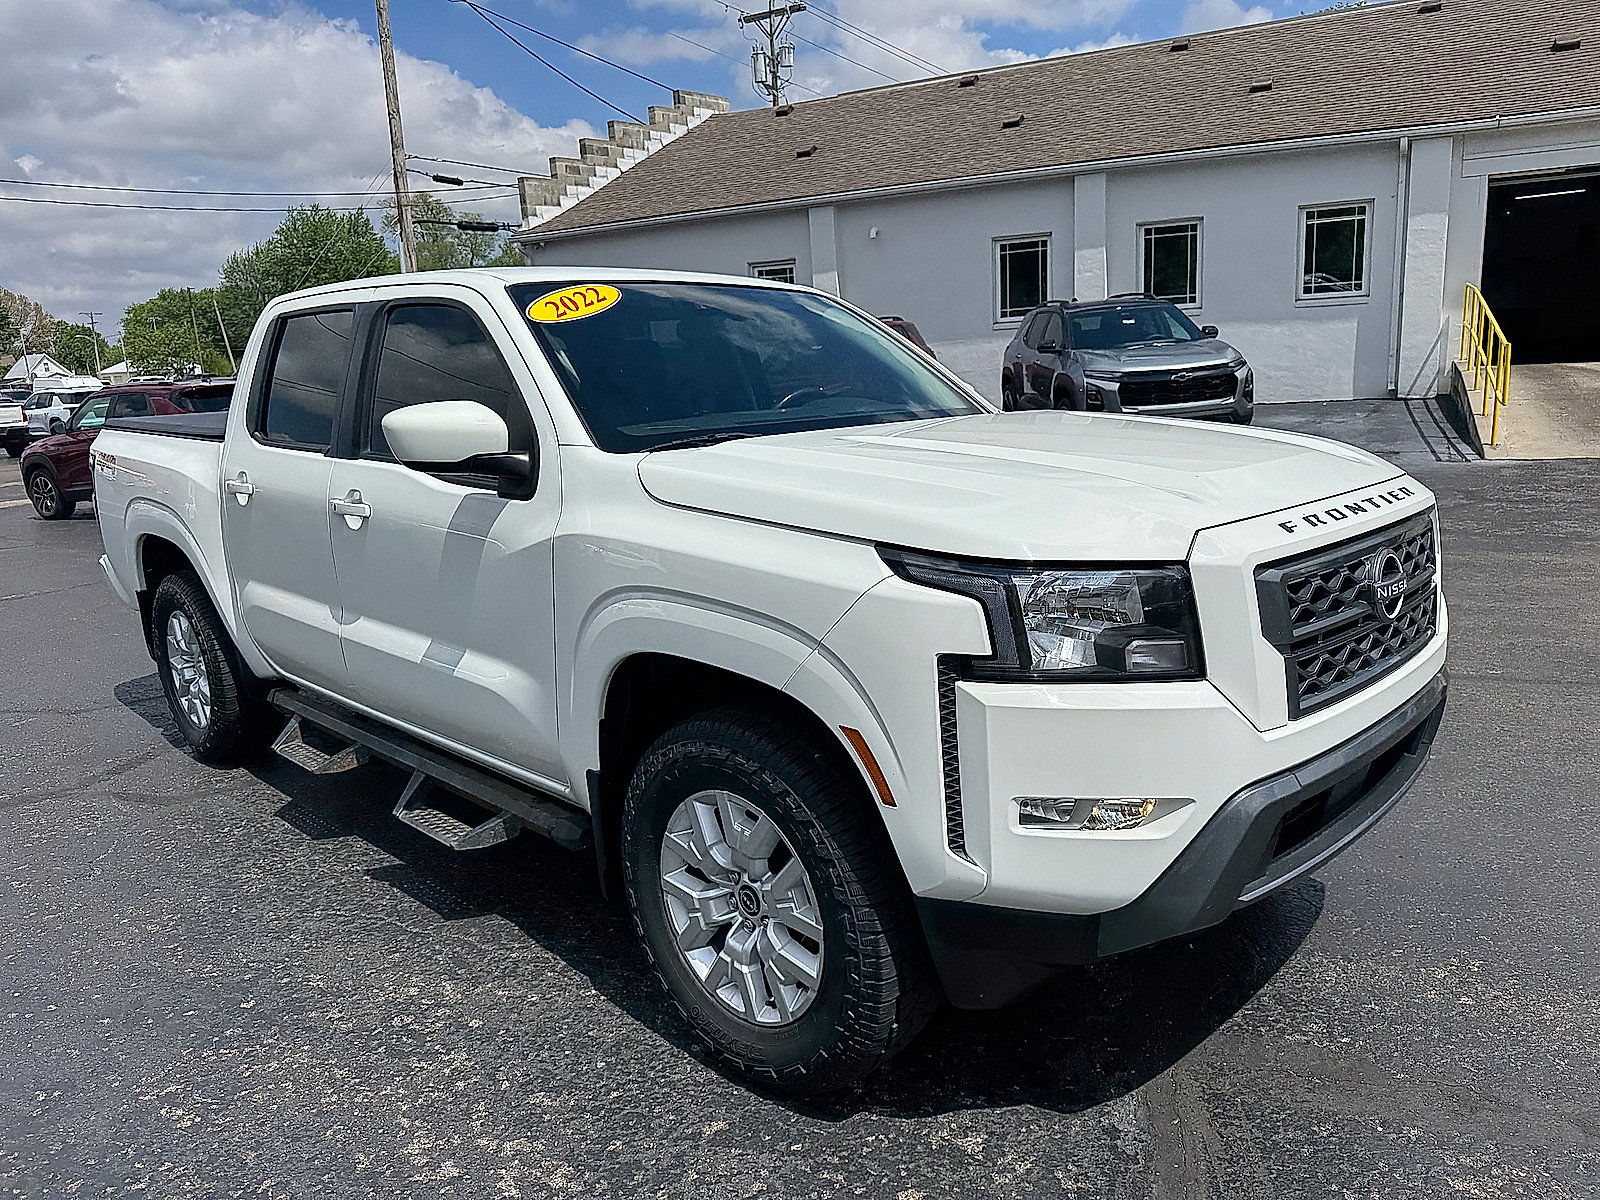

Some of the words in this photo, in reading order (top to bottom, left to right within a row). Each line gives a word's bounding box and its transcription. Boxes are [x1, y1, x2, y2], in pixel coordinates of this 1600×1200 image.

[544, 287, 608, 319] 2022
[1277, 486, 1416, 534] FRONTIER
[1376, 578, 1408, 600] NISS
